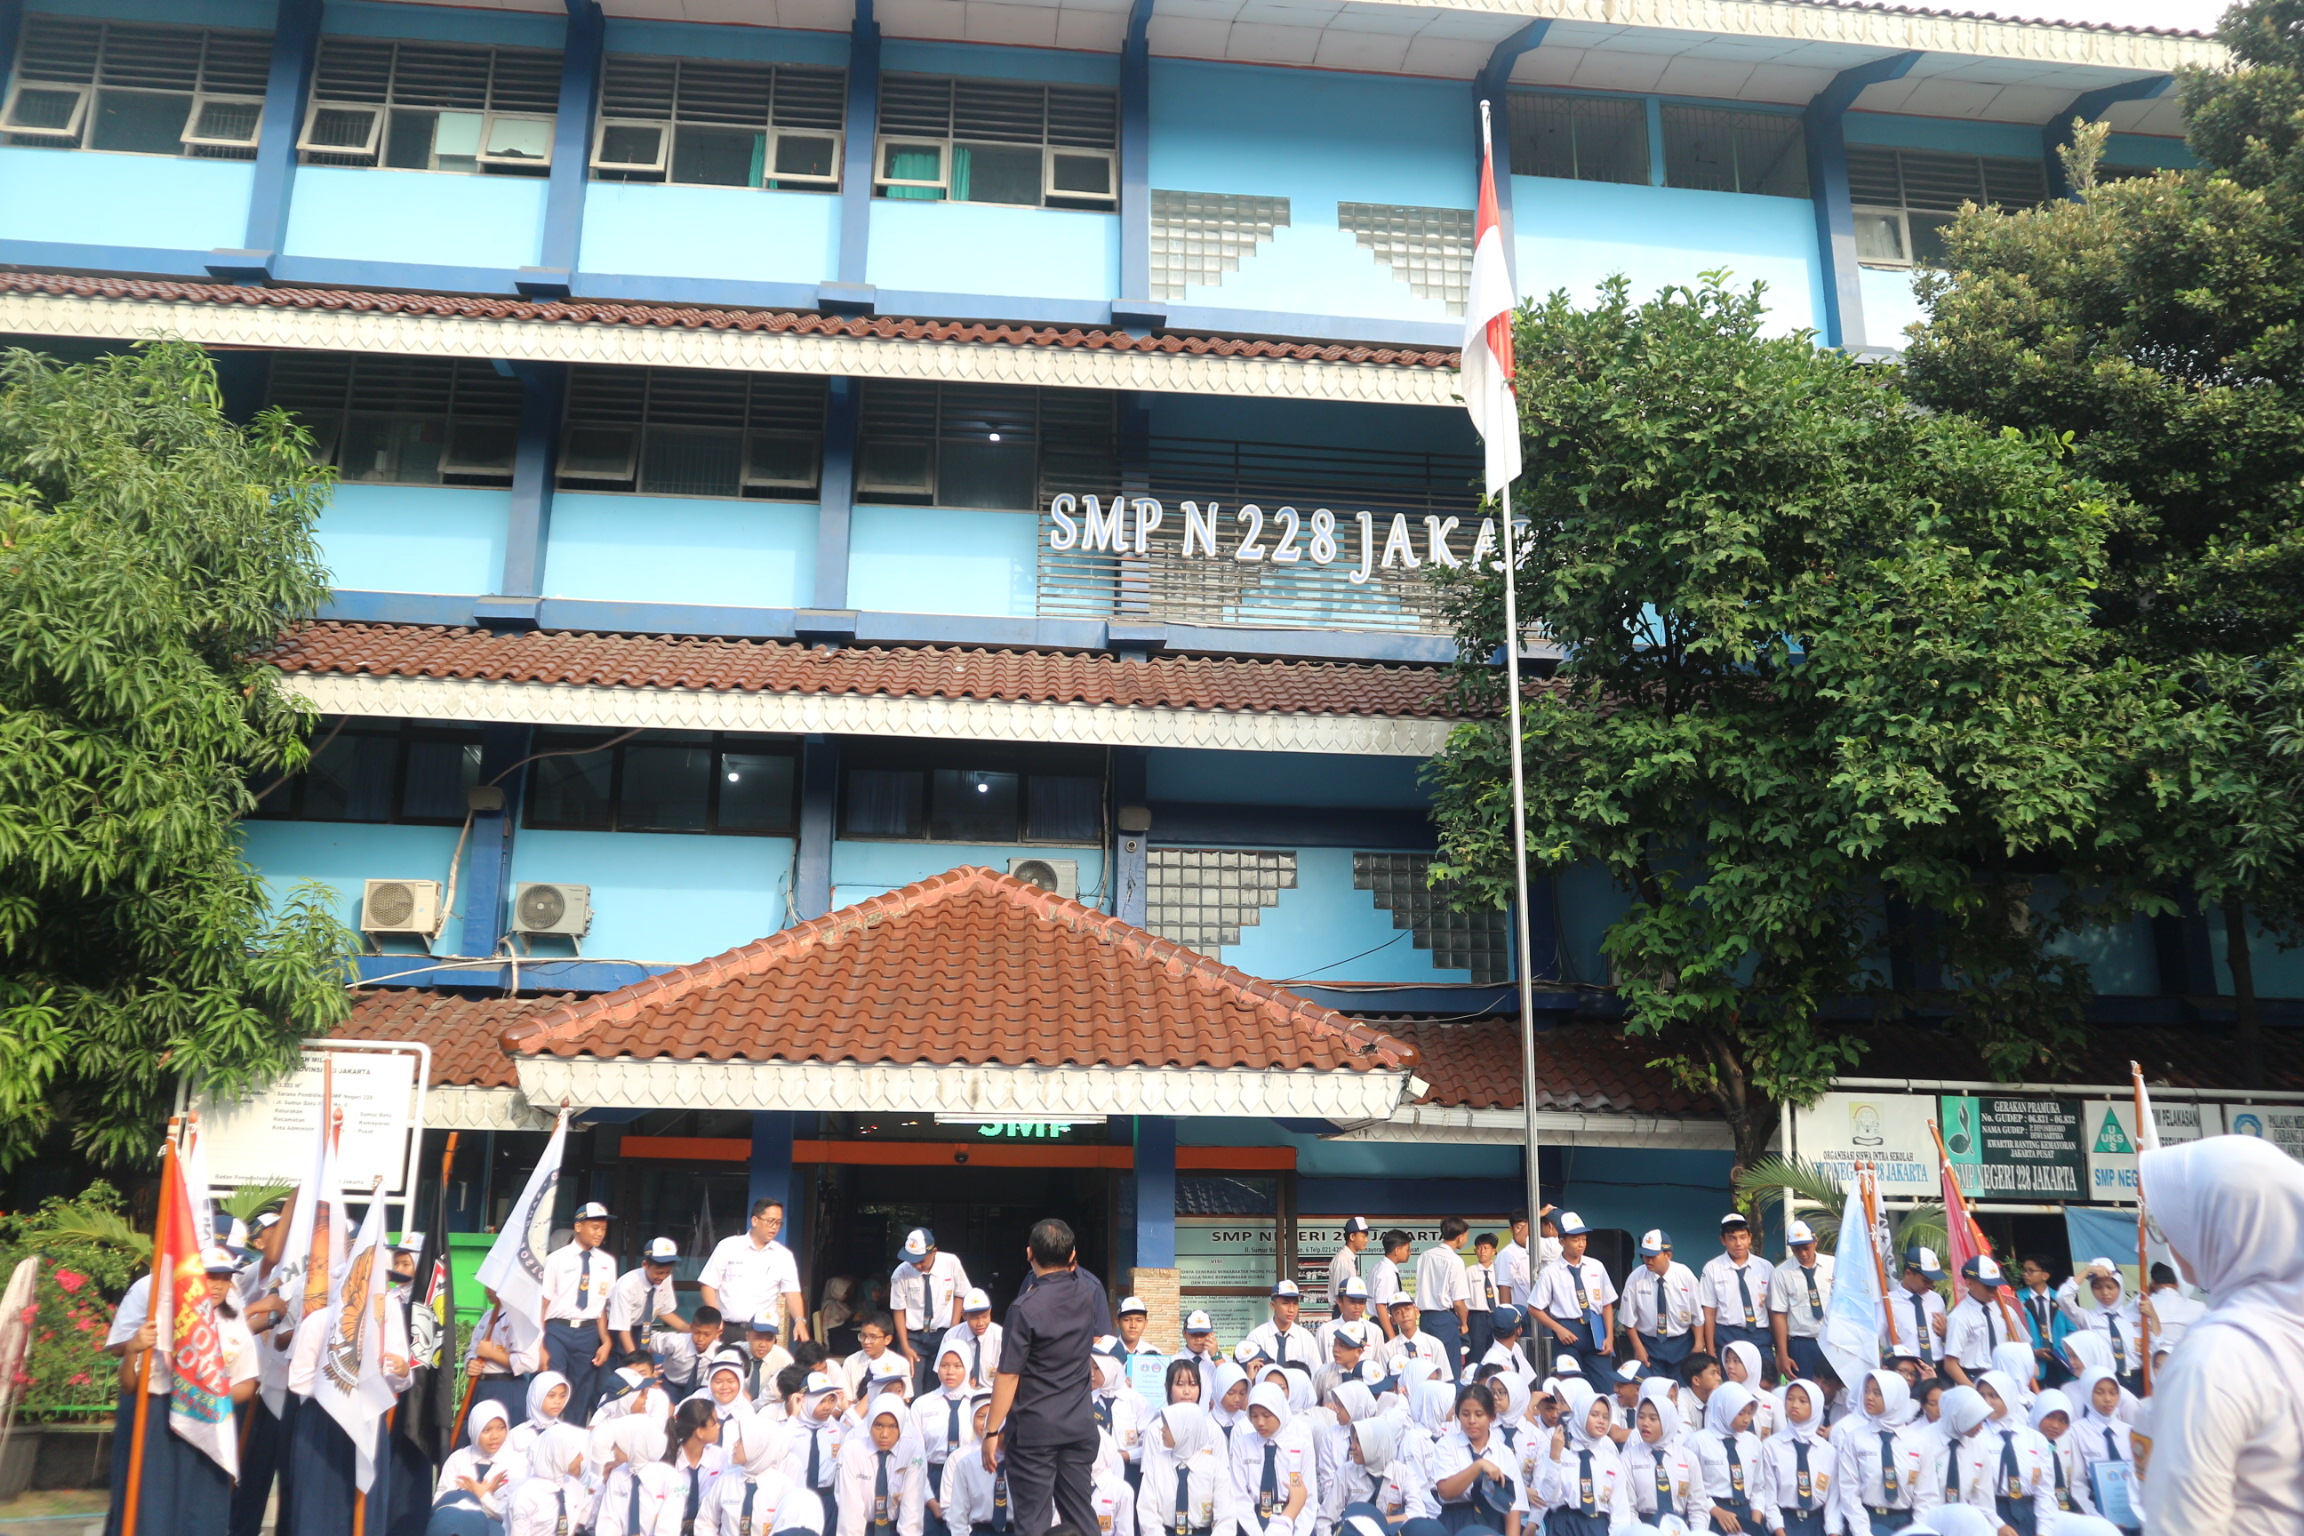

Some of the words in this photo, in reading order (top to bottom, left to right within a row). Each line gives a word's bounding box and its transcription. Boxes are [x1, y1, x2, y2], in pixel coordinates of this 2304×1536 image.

[1050, 493, 1163, 556] SMP
[1180, 501, 1220, 559] N
[1235, 503, 1338, 566] 228
[1994, 1101, 2027, 1113] GERAKAN
[2027, 1102, 2061, 1114] PRAMUKA
[1981, 1113, 1994, 1122] No.
[1995, 1113, 2023, 1123] GUDEP
[2028, 1114, 2049, 1124] 06.831
[2054, 1115, 2077, 1125] 06.832
[1981, 1126, 2002, 1134] NAMA
[2002, 1126, 2024, 1135] GUDEP
[2100, 1133, 2124, 1143] UKS
[1987, 1139, 2015, 1148] KWARTIR
[2015, 1140, 2040, 1149] RANTING
[2040, 1141, 2077, 1150] KEMAYORAN
[1823, 1150, 1855, 1161] ORGANISASI
[1855, 1151, 1872, 1161] SISWA
[1872, 1151, 1889, 1161] INTRA
[1889, 1152, 1914, 1162] SEKOLAH
[2010, 1149, 2036, 1158] JAKARTA
[2036, 1150, 2054, 1158] PUSAT
[1886, 1162, 1929, 1182] JAKARTA
[1977, 1164, 2016, 1190] NEGERI
[2016, 1165, 2032, 1191] 228
[2032, 1165, 2078, 1191] JAKARTA
[2094, 1168, 2115, 1187] SMP
[1211, 1231, 1252, 1242] SMP
